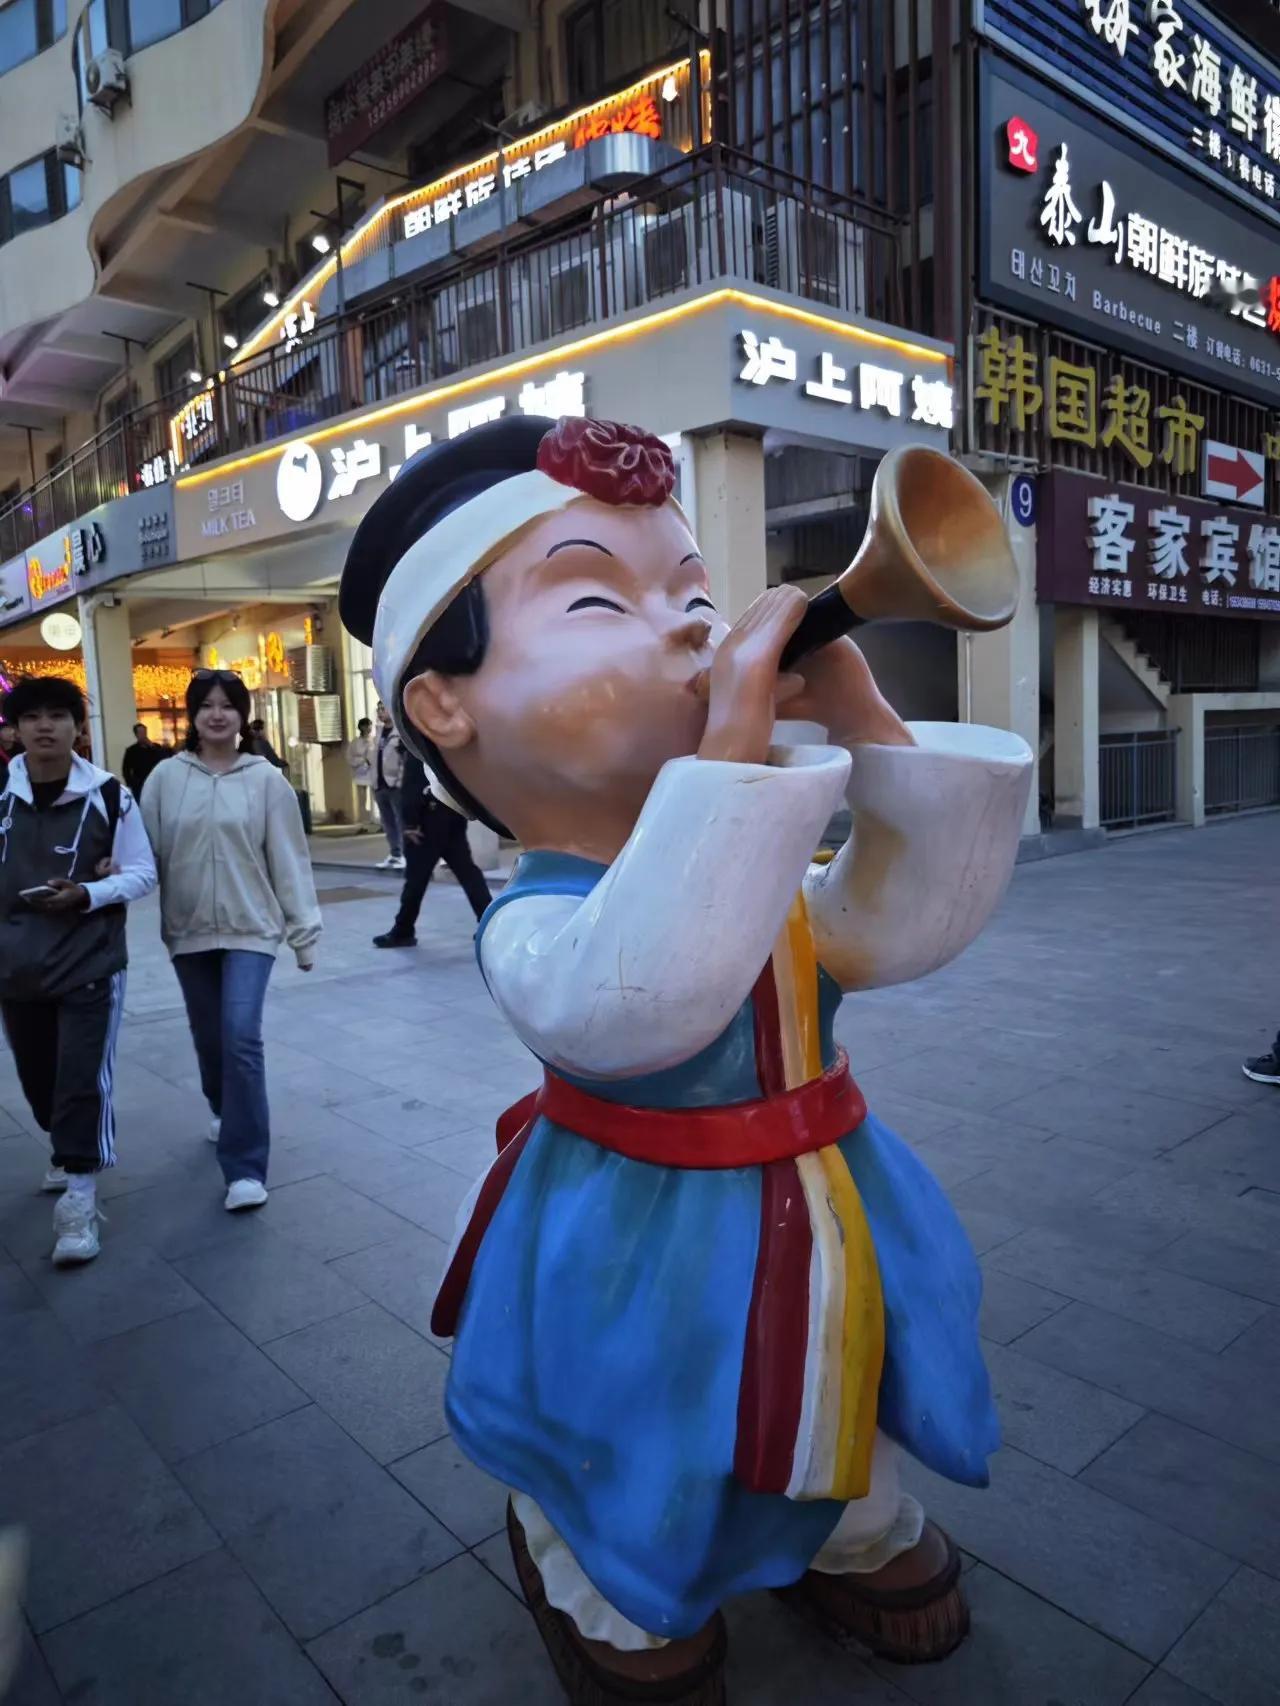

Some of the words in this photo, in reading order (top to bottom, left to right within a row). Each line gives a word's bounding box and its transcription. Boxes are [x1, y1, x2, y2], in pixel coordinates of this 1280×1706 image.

[1092, 289, 1162, 335] Barbecue
[1172, 320, 1198, 350] 二楼
[975, 325, 1205, 476] 韩国超市
[208, 480, 243, 511] 밀크티
[1018, 483, 1033, 517] 9
[200, 518, 230, 538] MILK
[231, 508, 257, 531] TEA
[1088, 493, 1280, 592] 客家宾馆
[1088, 576, 1132, 599] 经济实惠
[1147, 583, 1189, 604] 环保卫生
